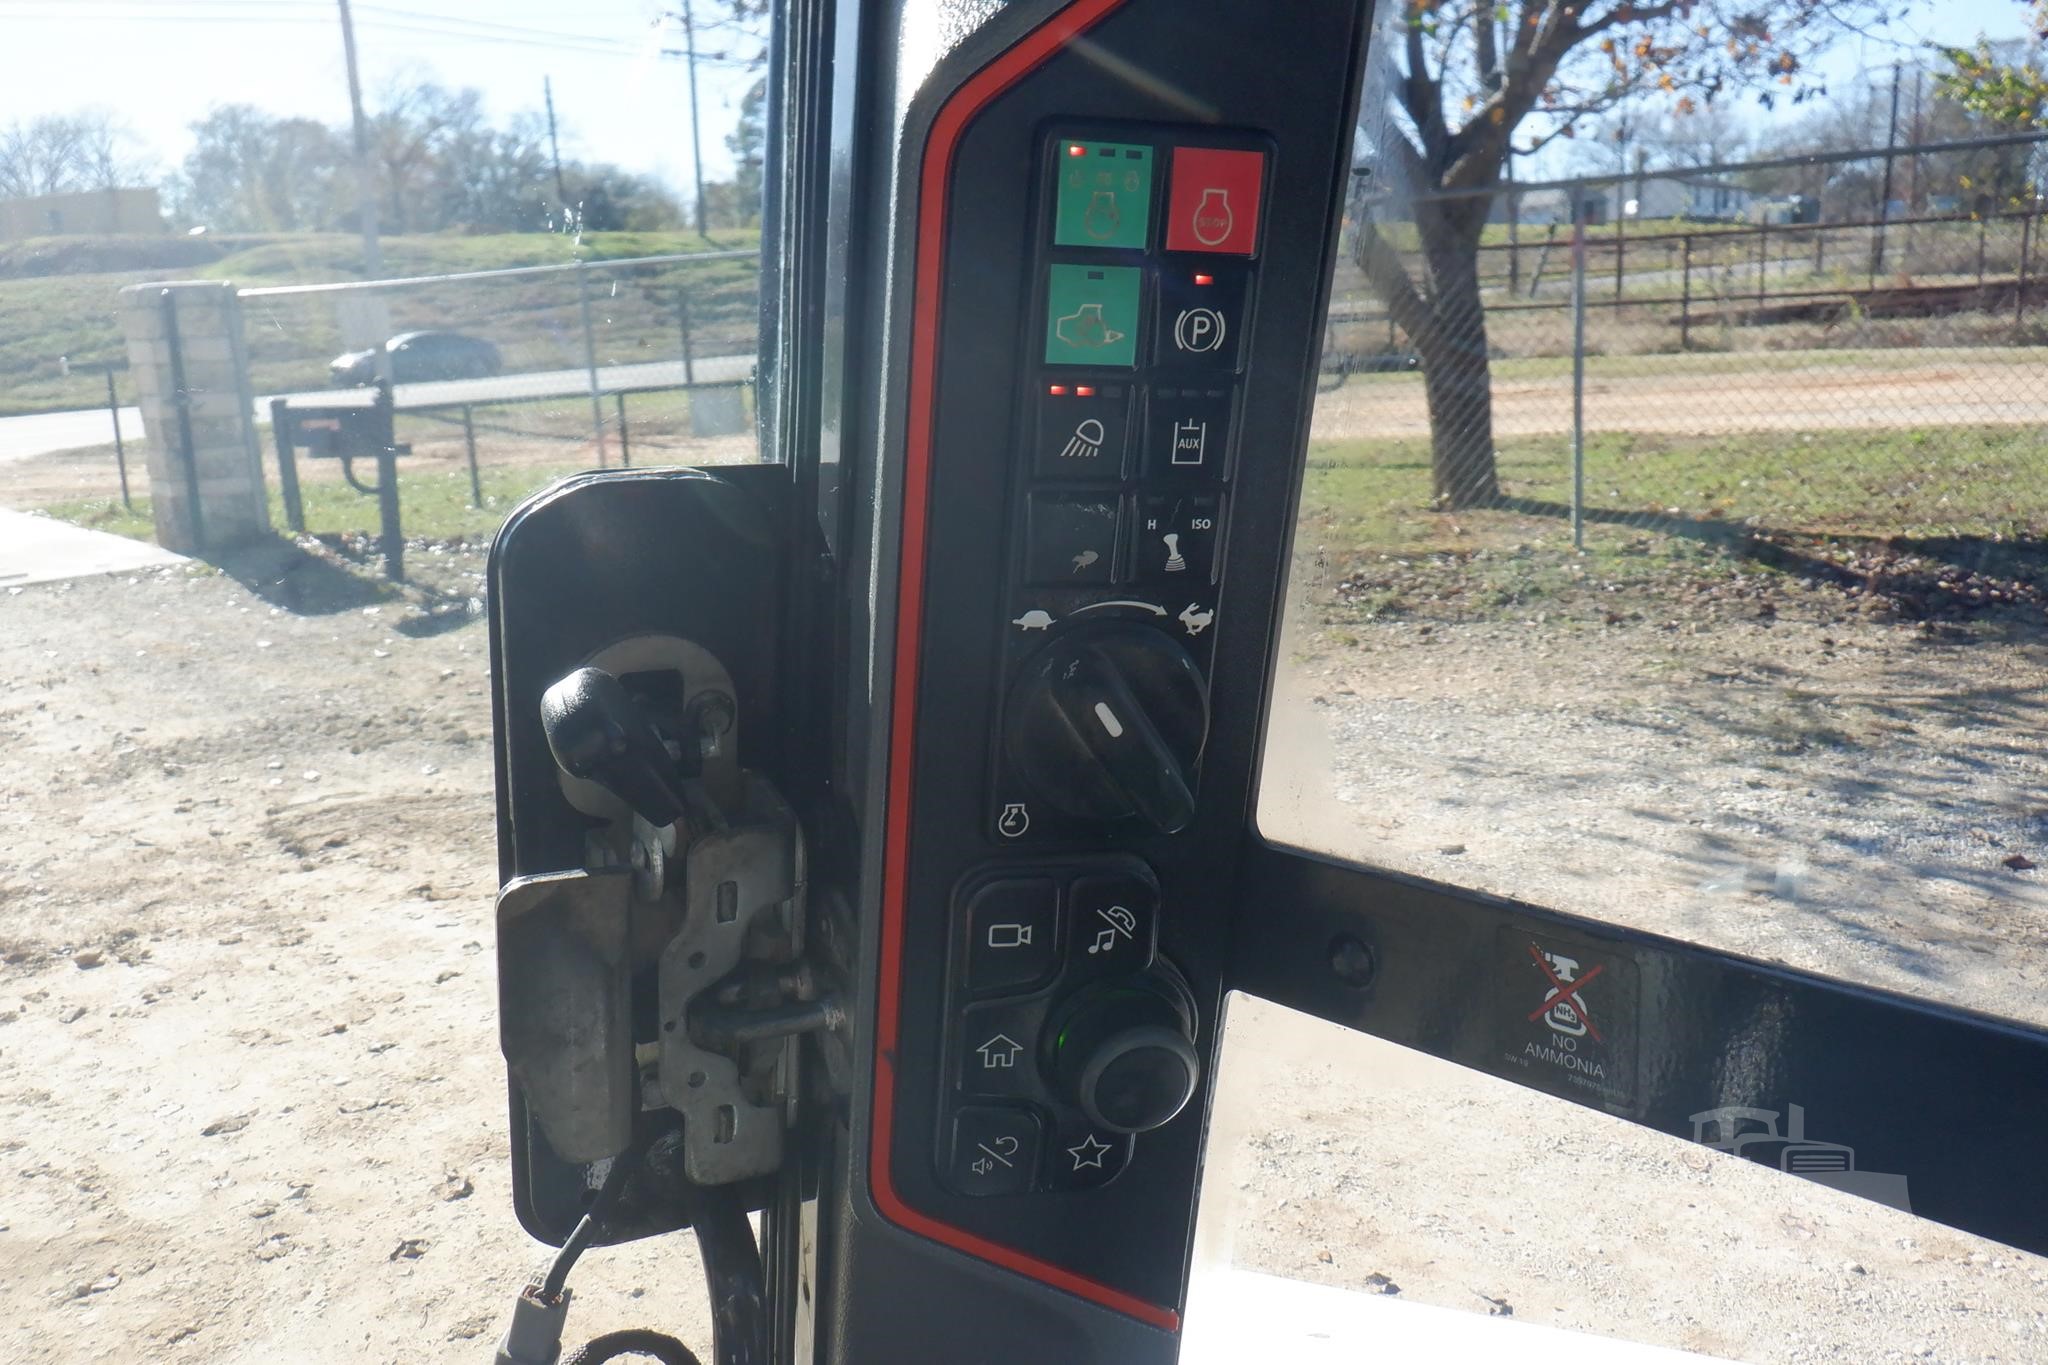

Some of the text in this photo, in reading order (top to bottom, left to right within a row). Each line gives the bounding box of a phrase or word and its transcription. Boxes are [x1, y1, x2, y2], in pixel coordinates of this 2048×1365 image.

[1193, 316, 1210, 345] P
[1178, 438, 1200, 449] AUX
[1147, 520, 1157, 530] H
[1192, 519, 1211, 530] ISO
[1552, 1033, 1577, 1051] NO
[1524, 1041, 1606, 1078] AMMONIA
